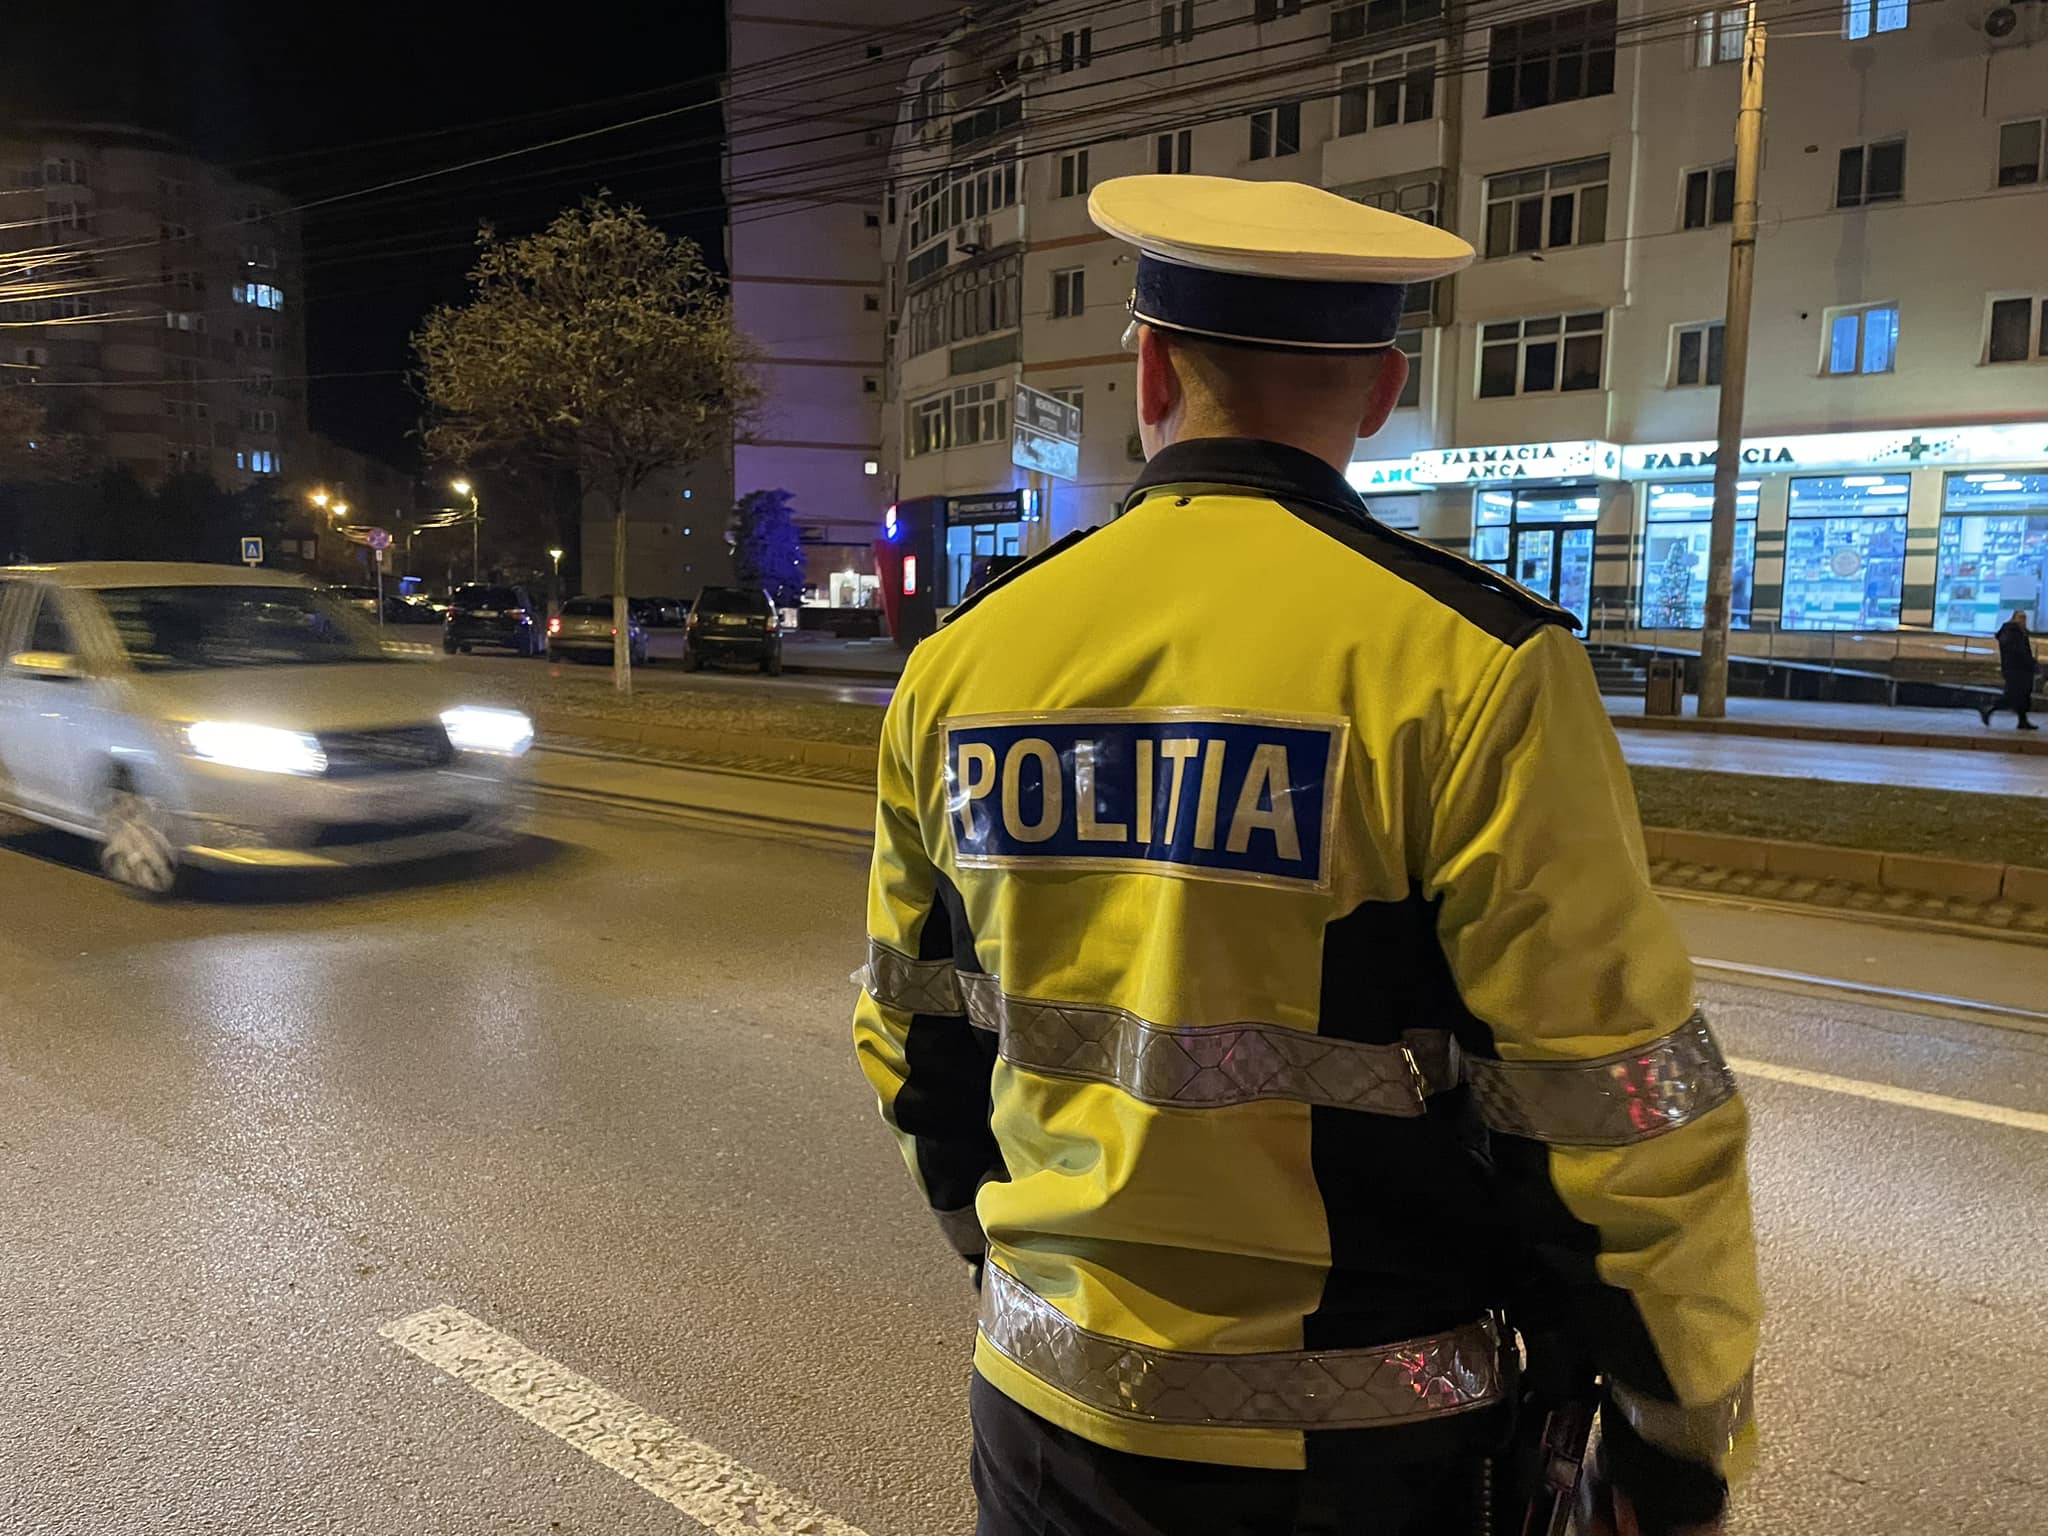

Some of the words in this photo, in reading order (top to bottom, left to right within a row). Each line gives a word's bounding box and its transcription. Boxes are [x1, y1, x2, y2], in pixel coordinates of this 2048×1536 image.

[1442, 447, 1555, 465] FARMACIA
[1644, 447, 1794, 469] FARMCIA
[1467, 465, 1527, 478] ANCA
